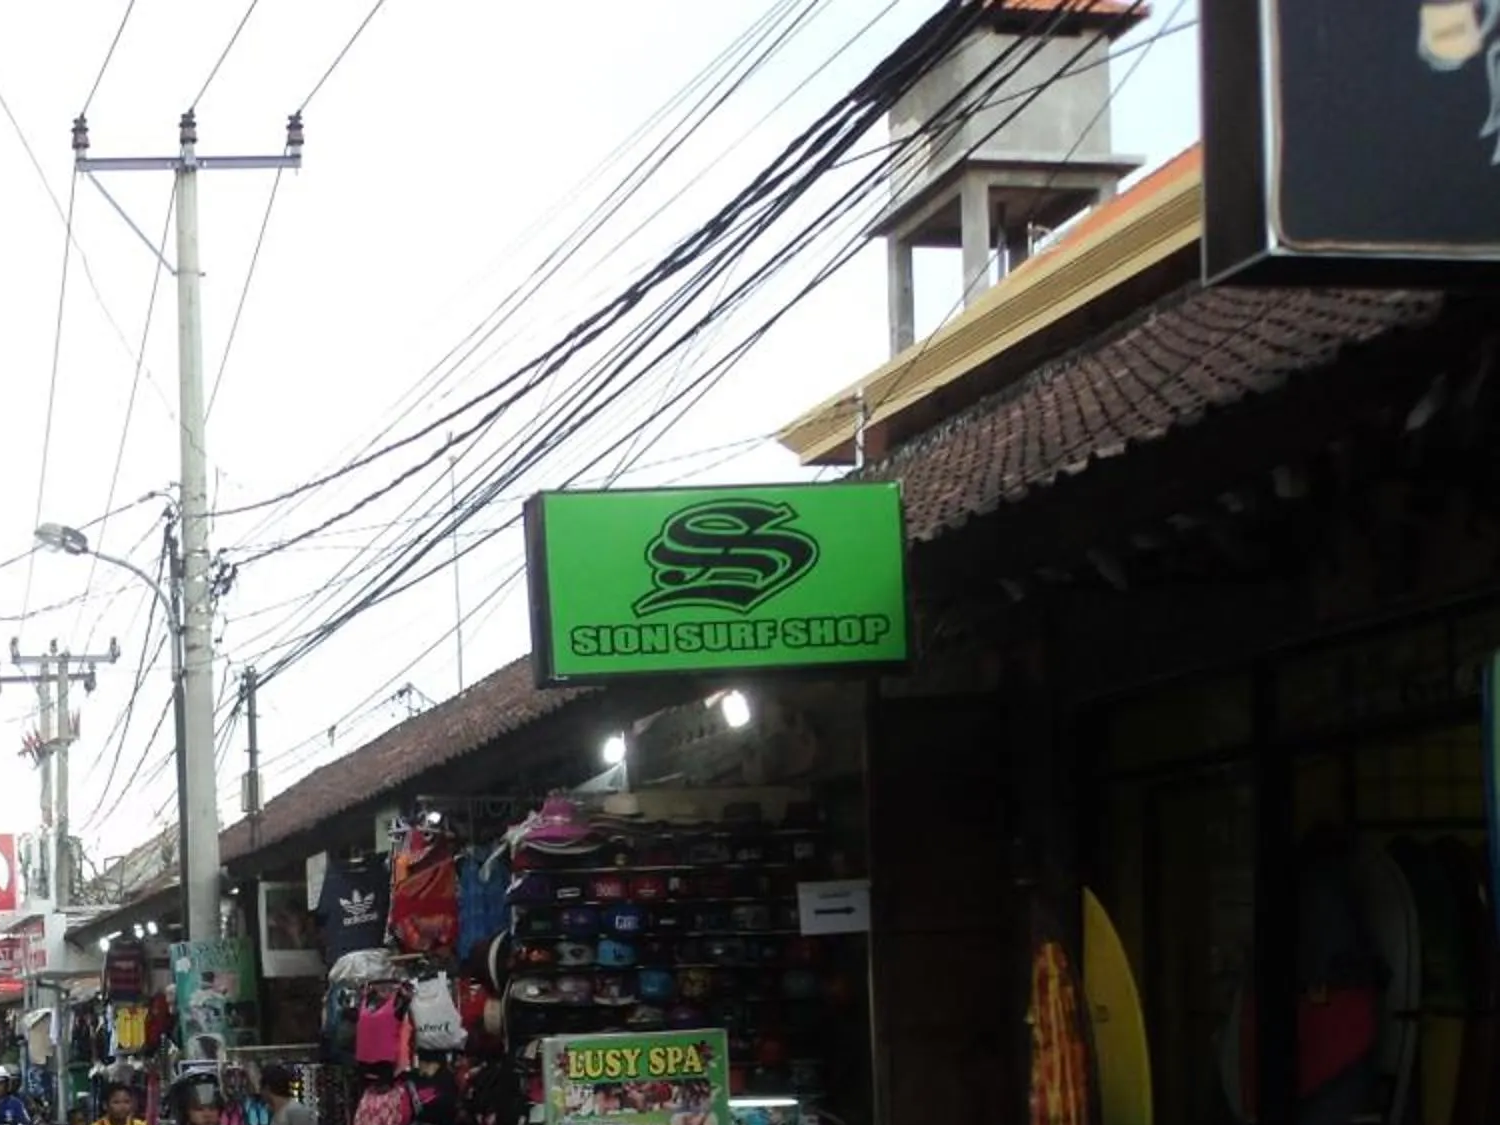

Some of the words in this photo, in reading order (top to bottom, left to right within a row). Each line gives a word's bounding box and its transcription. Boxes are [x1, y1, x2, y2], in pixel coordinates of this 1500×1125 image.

[570, 623, 668, 656] SION
[674, 619, 779, 652] SURF
[783, 613, 890, 648] SHOP
[649, 1044, 704, 1075] SPA
